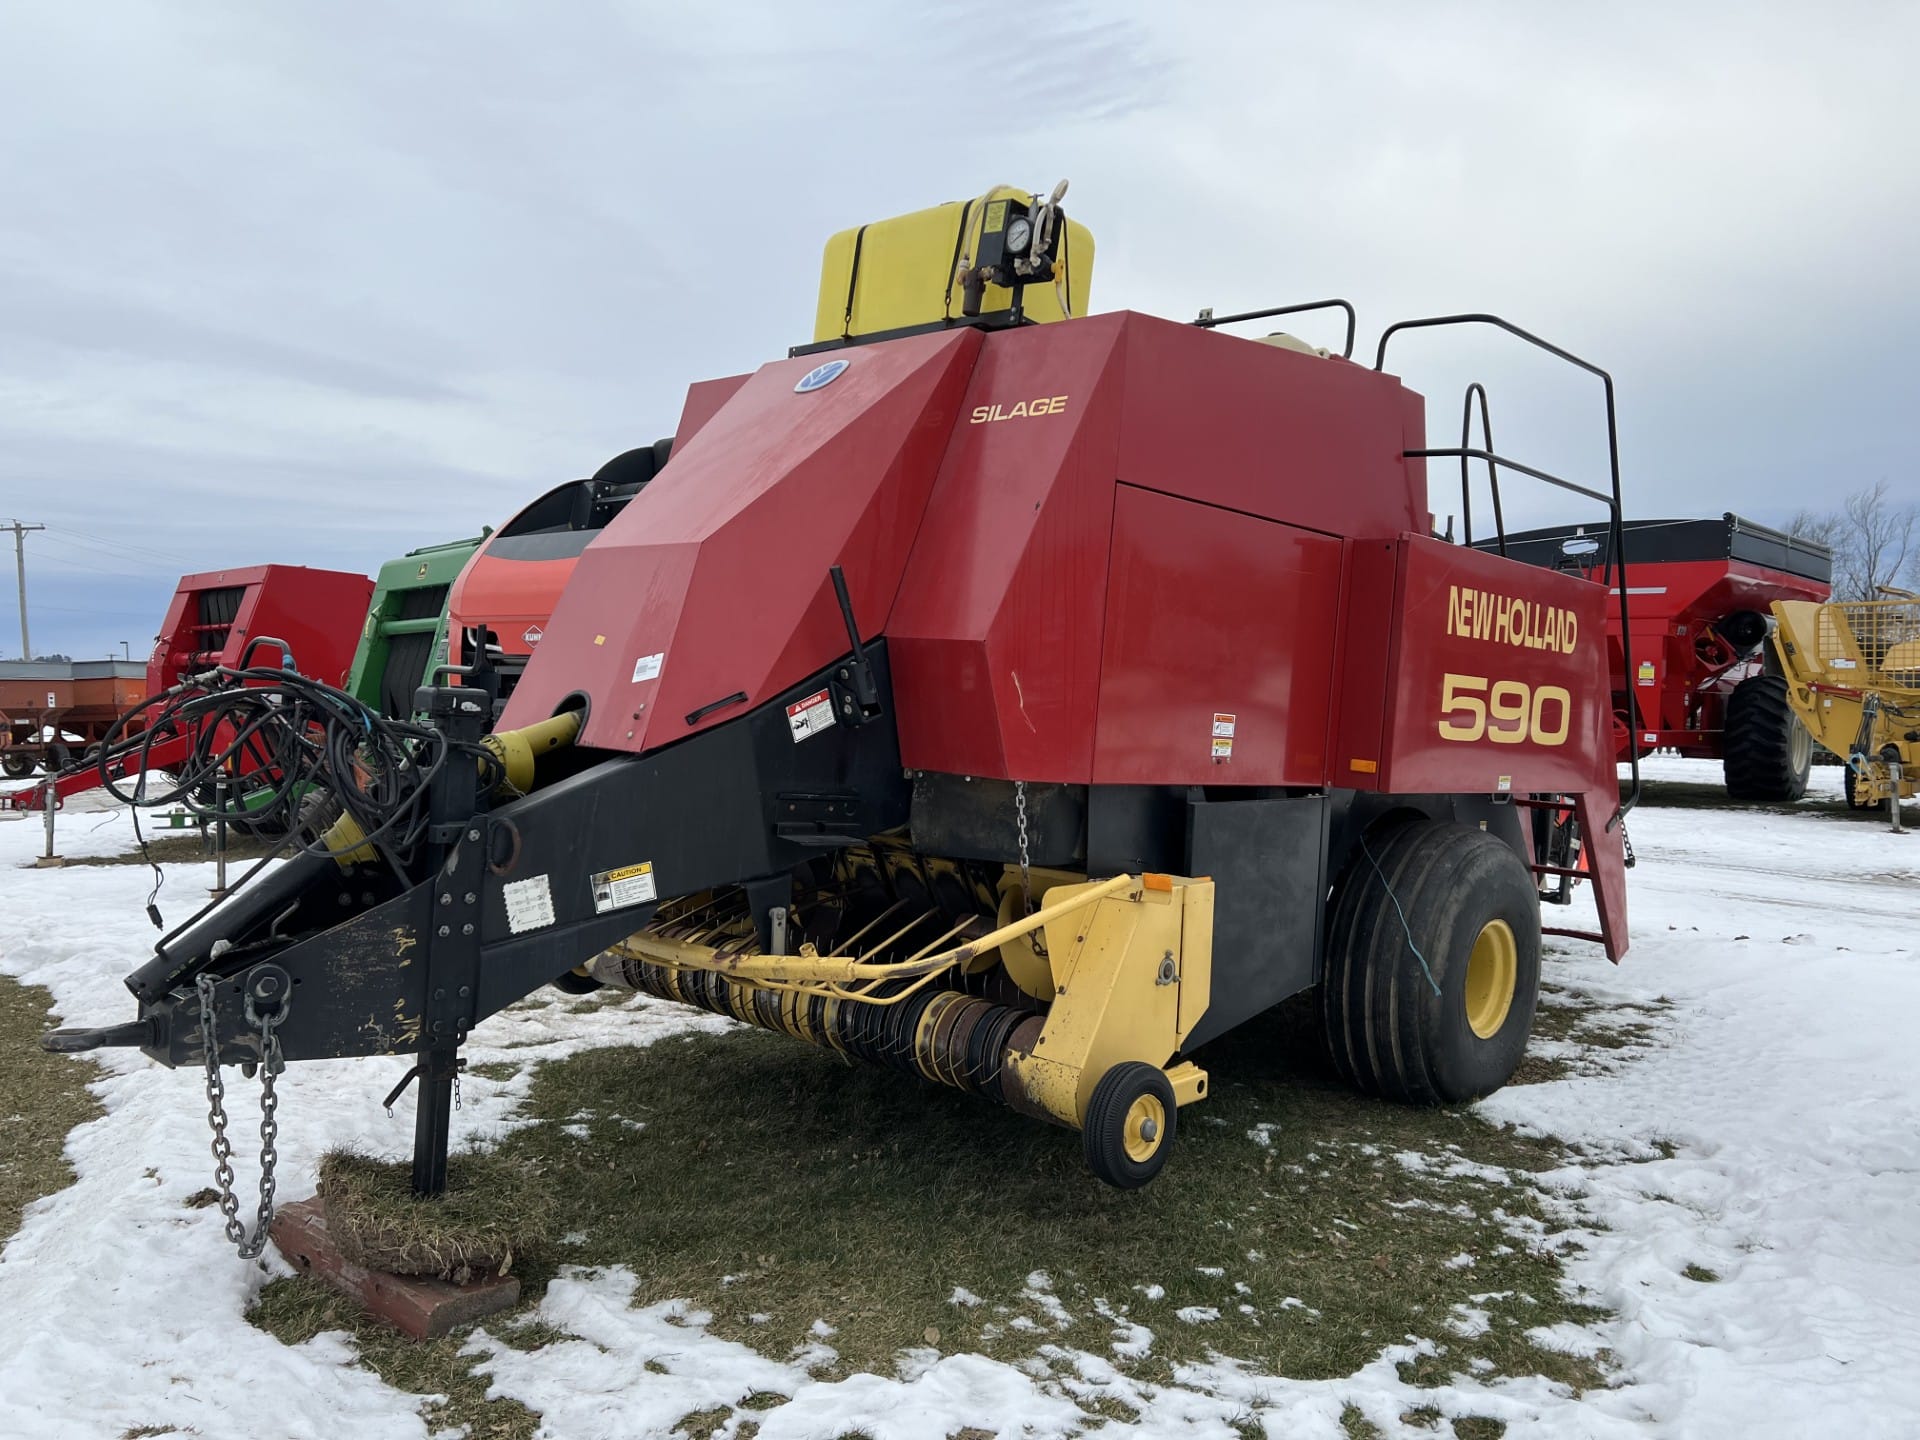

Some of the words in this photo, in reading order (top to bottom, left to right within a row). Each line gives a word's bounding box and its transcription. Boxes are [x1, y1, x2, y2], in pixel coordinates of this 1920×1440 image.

[970, 395, 1069, 424] SILAGE
[1447, 585, 1495, 641] NEW
[1494, 595, 1578, 654] HOLLAND
[801, 695, 822, 709] DANGER
[1438, 672, 1571, 746] 590
[611, 867, 642, 879] CAUTION
